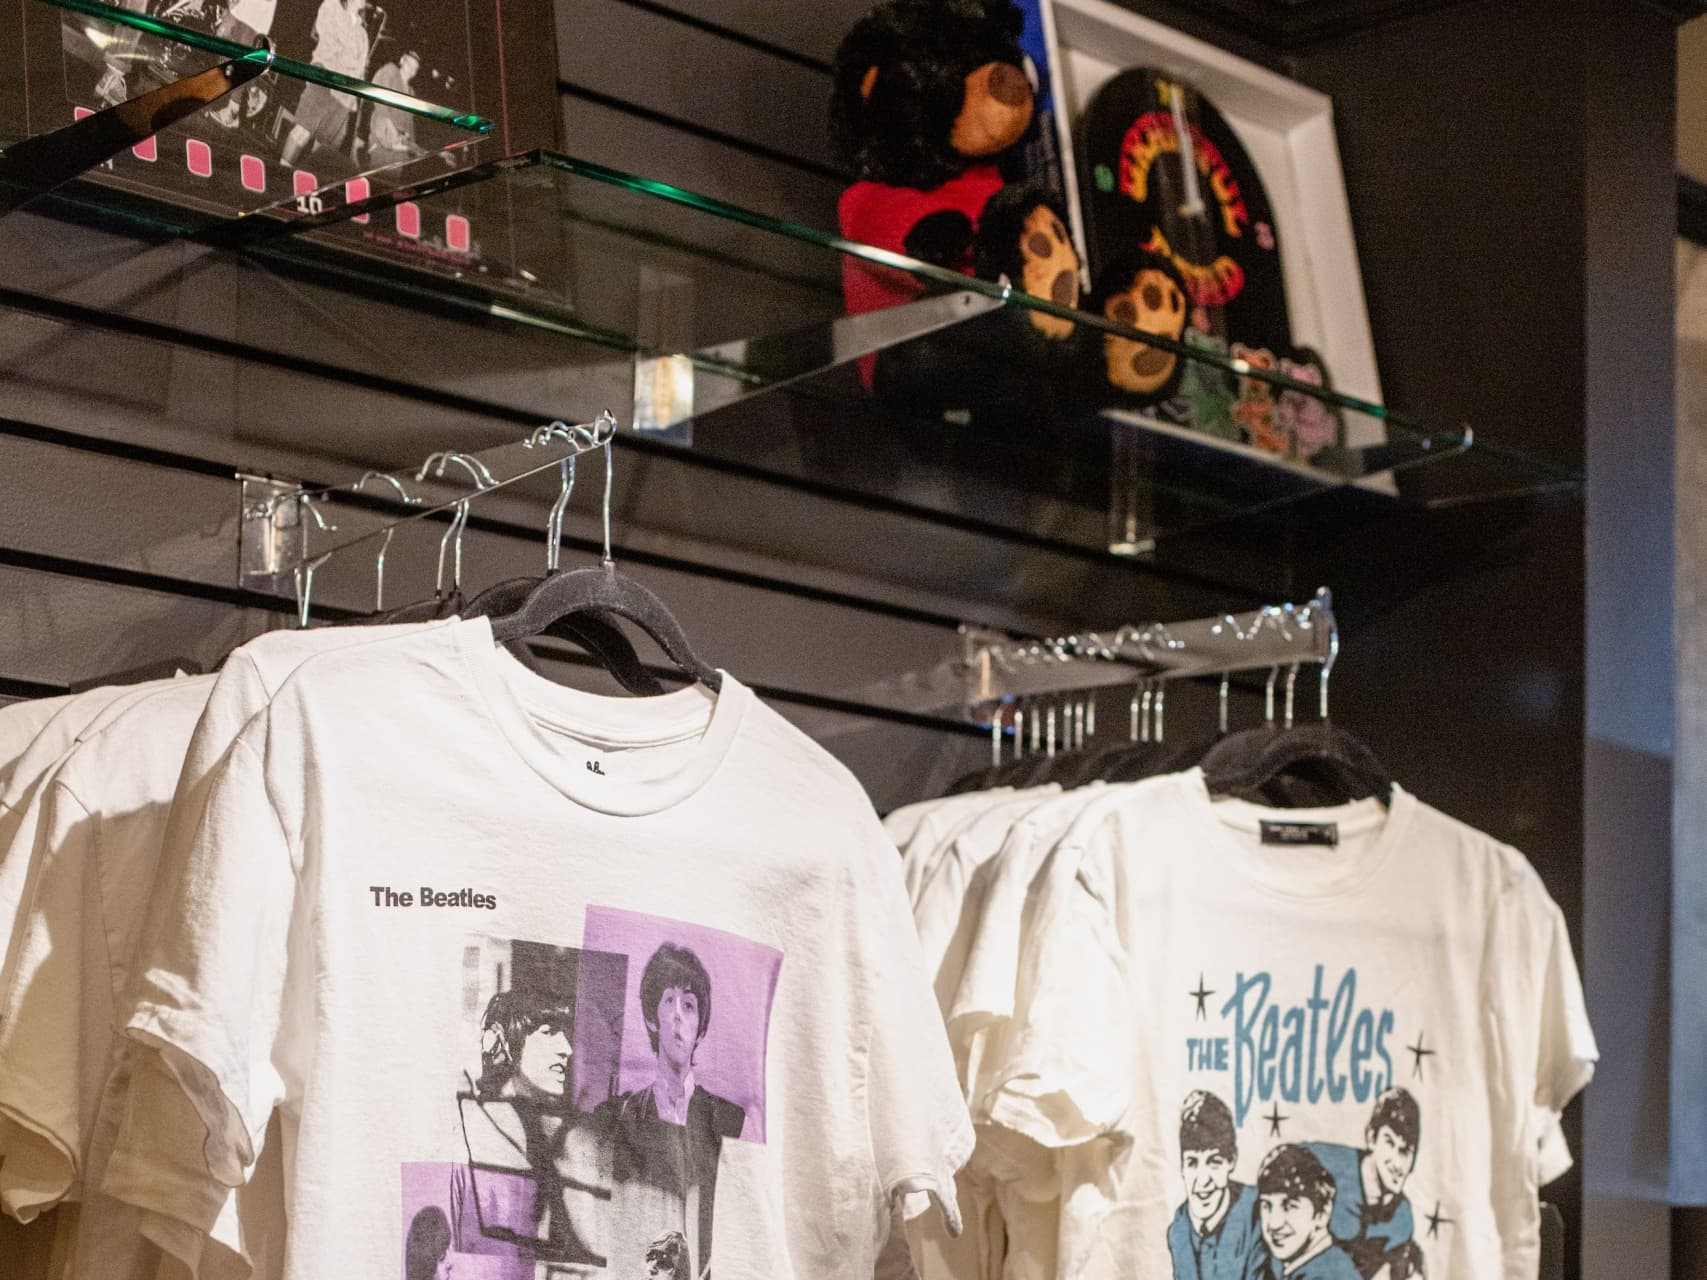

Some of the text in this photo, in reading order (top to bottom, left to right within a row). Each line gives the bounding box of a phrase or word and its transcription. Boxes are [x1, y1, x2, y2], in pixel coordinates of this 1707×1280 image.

[369, 886, 497, 910] The Beatles
[1186, 963, 1395, 1129] THE Beatles
